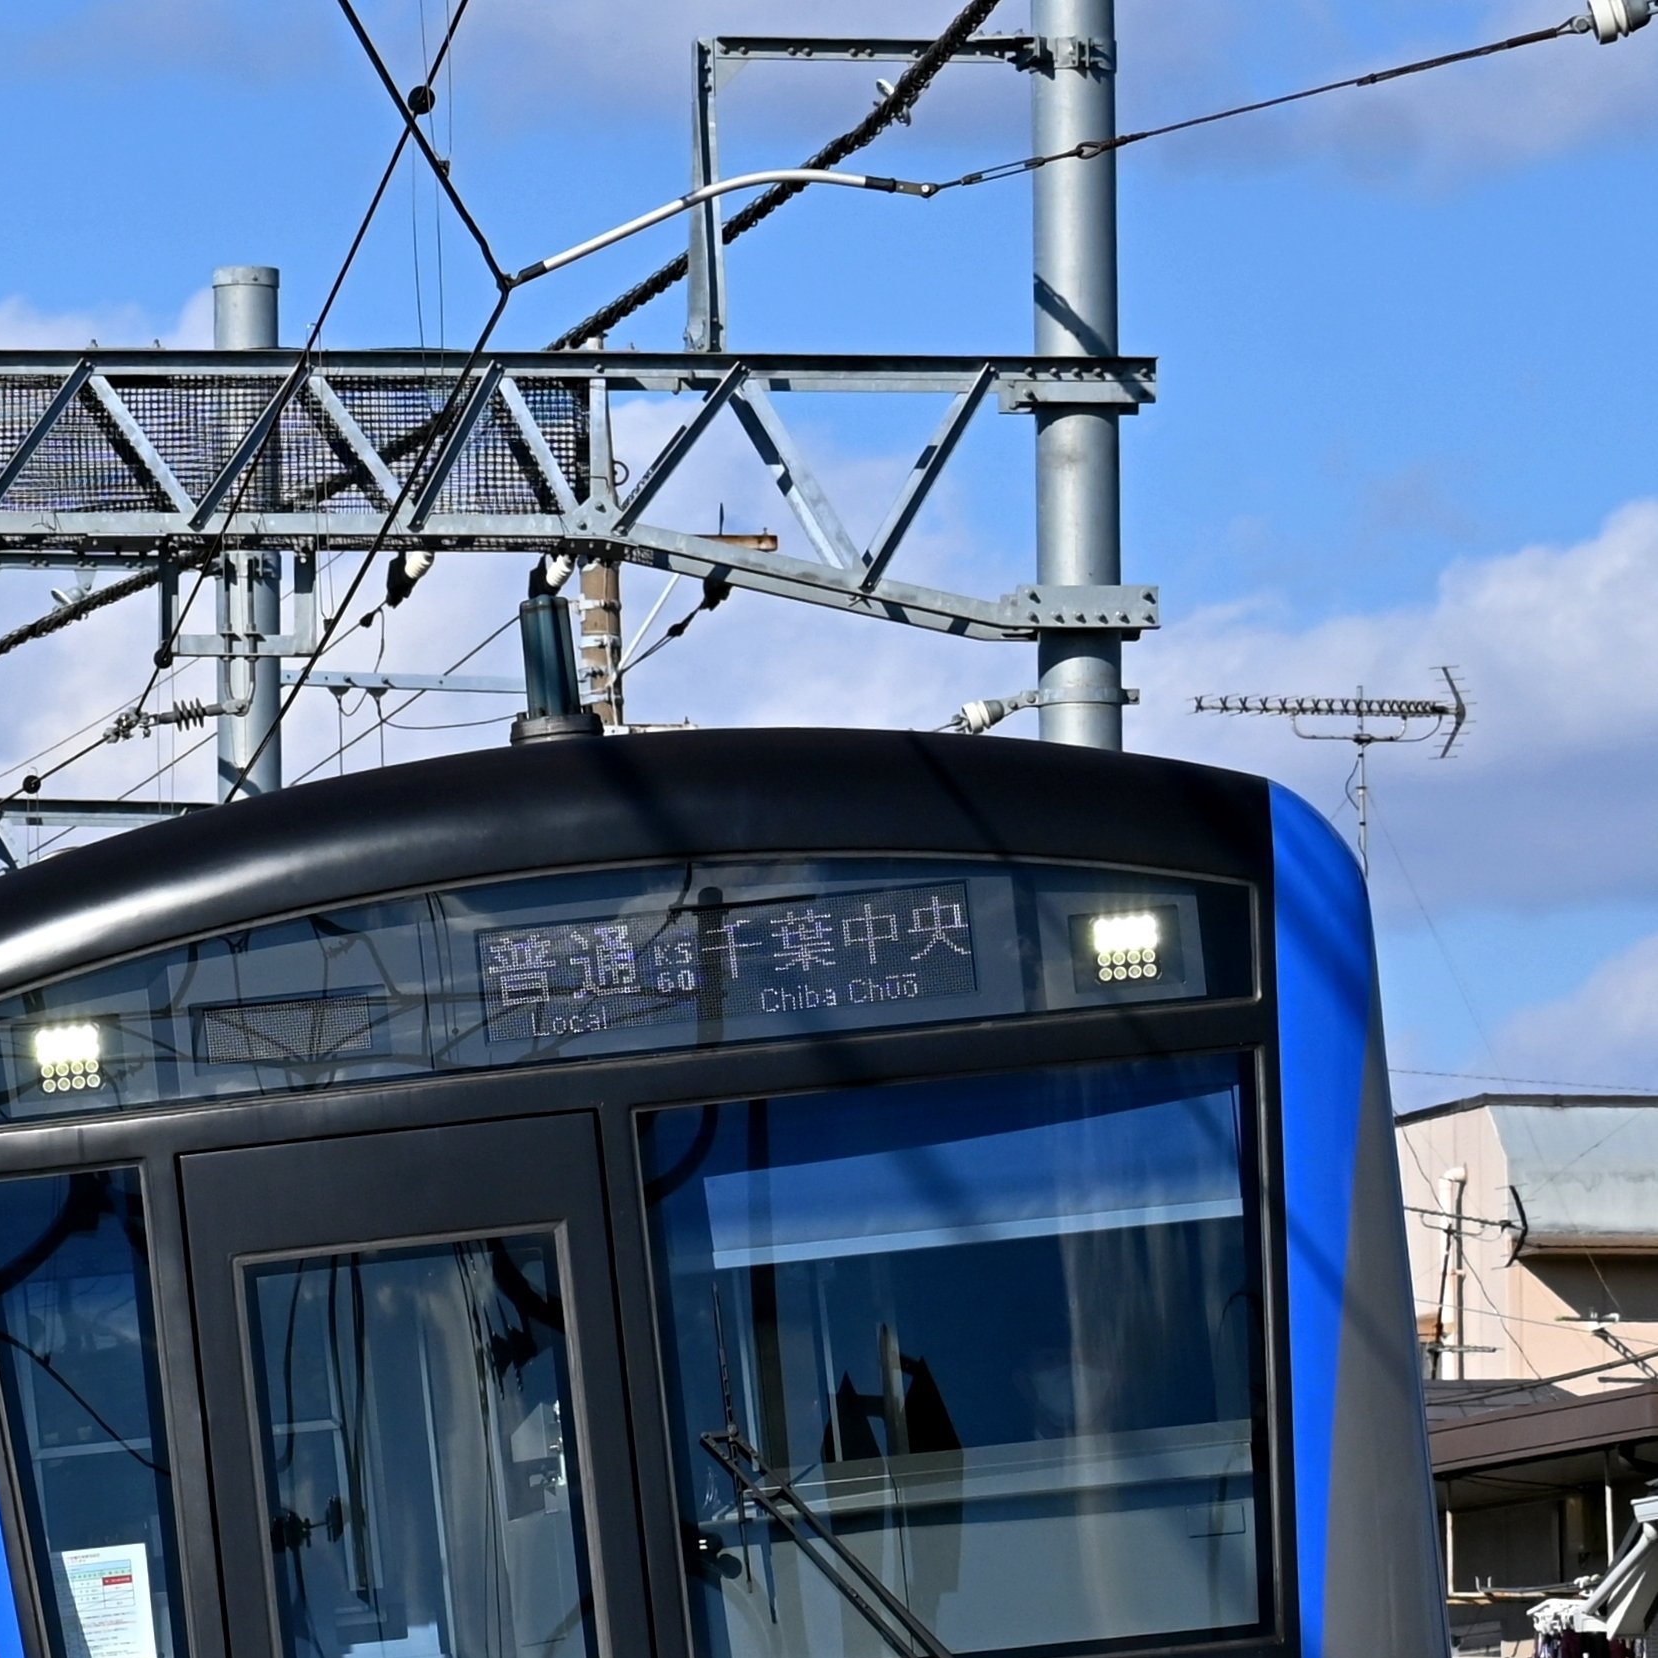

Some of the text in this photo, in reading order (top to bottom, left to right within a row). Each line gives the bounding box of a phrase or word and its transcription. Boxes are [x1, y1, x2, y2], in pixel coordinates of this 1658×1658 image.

[654, 940, 693, 966] KS
[701, 895, 972, 980] 千葉中央
[488, 923, 641, 1008] 普通
[656, 969, 696, 994] 60
[760, 983, 837, 1014] Chiba
[531, 1006, 609, 1037] Local
